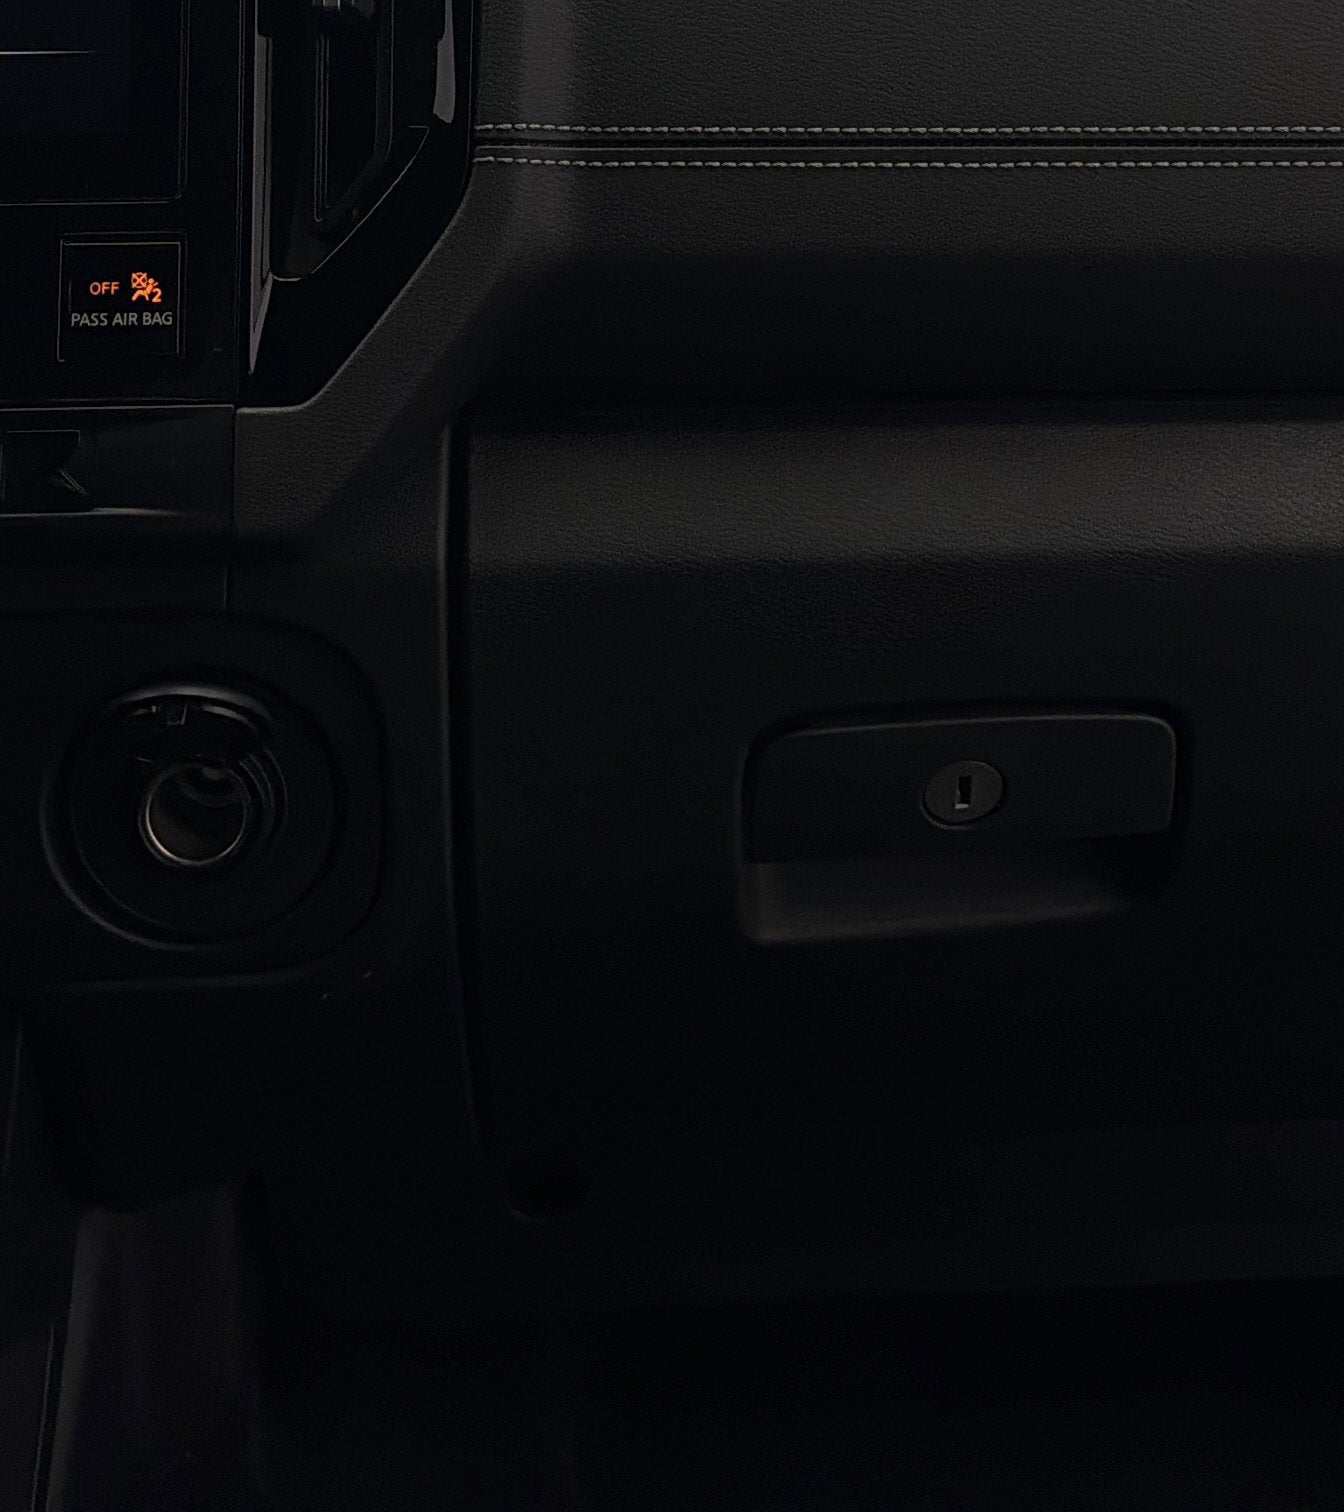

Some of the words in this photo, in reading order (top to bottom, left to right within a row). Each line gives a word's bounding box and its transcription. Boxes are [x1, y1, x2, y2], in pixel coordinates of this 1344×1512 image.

[90, 282, 119, 295] OFF
[71, 313, 108, 326] PASS
[112, 313, 138, 326] AIR
[143, 312, 172, 325] BAG
